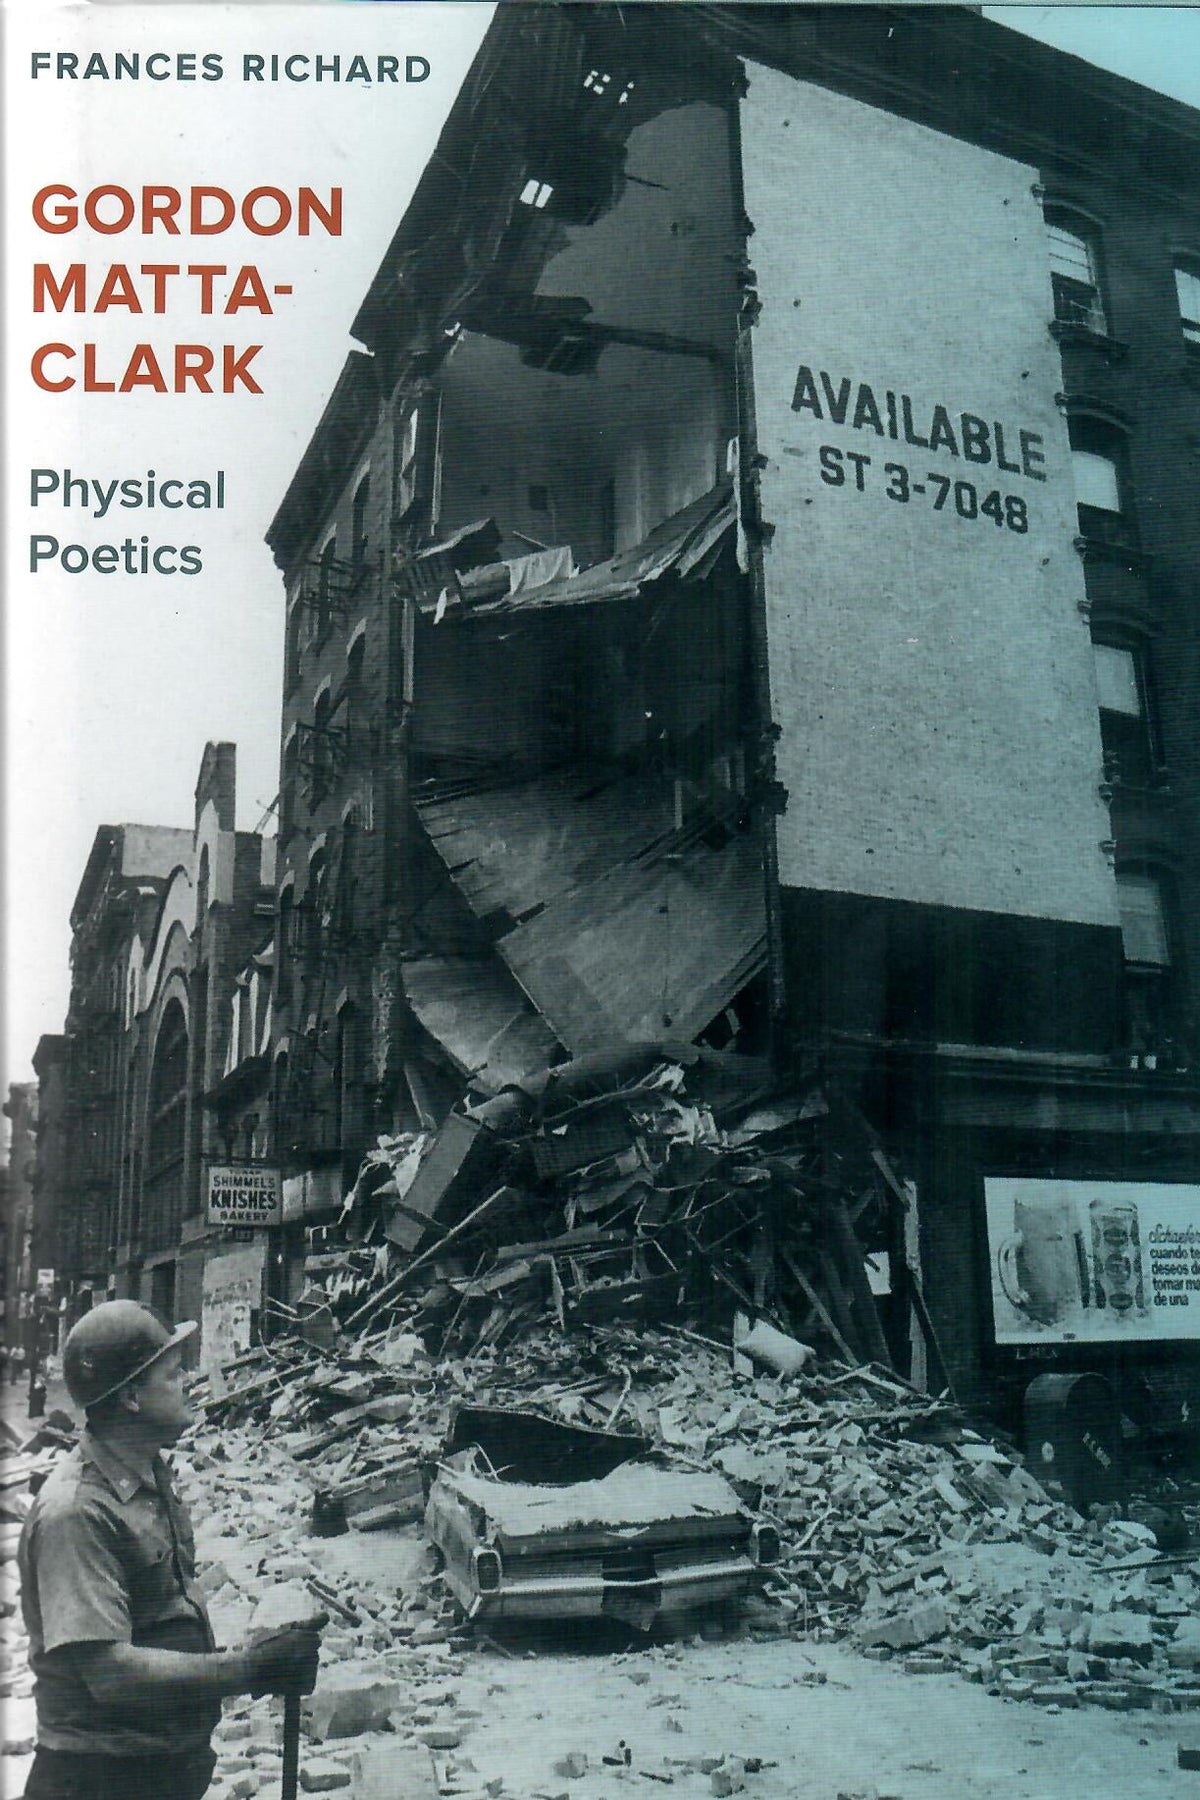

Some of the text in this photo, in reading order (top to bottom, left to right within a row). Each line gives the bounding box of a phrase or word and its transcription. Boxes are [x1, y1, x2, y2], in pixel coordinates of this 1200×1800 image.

[31, 53, 430, 82] FRANCES RICHARD
[32, 184, 342, 236] GORDON
[33, 264, 293, 314] MATTA-
[31, 343, 264, 394] CLARK
[791, 365, 1046, 482] AVAILABLE
[30, 469, 225, 518] Physical
[819, 445, 1028, 534] ST 3-7048
[30, 535, 203, 575] Poetics
[211, 1189, 277, 1210] KNISHES
[220, 1210, 269, 1221] BAKERY
[1150, 1245, 1188, 1259] cuando
[1152, 1261, 1189, 1275] deseos
[1153, 1278, 1184, 1291] tomar
[1154, 1291, 1189, 1306] de una
